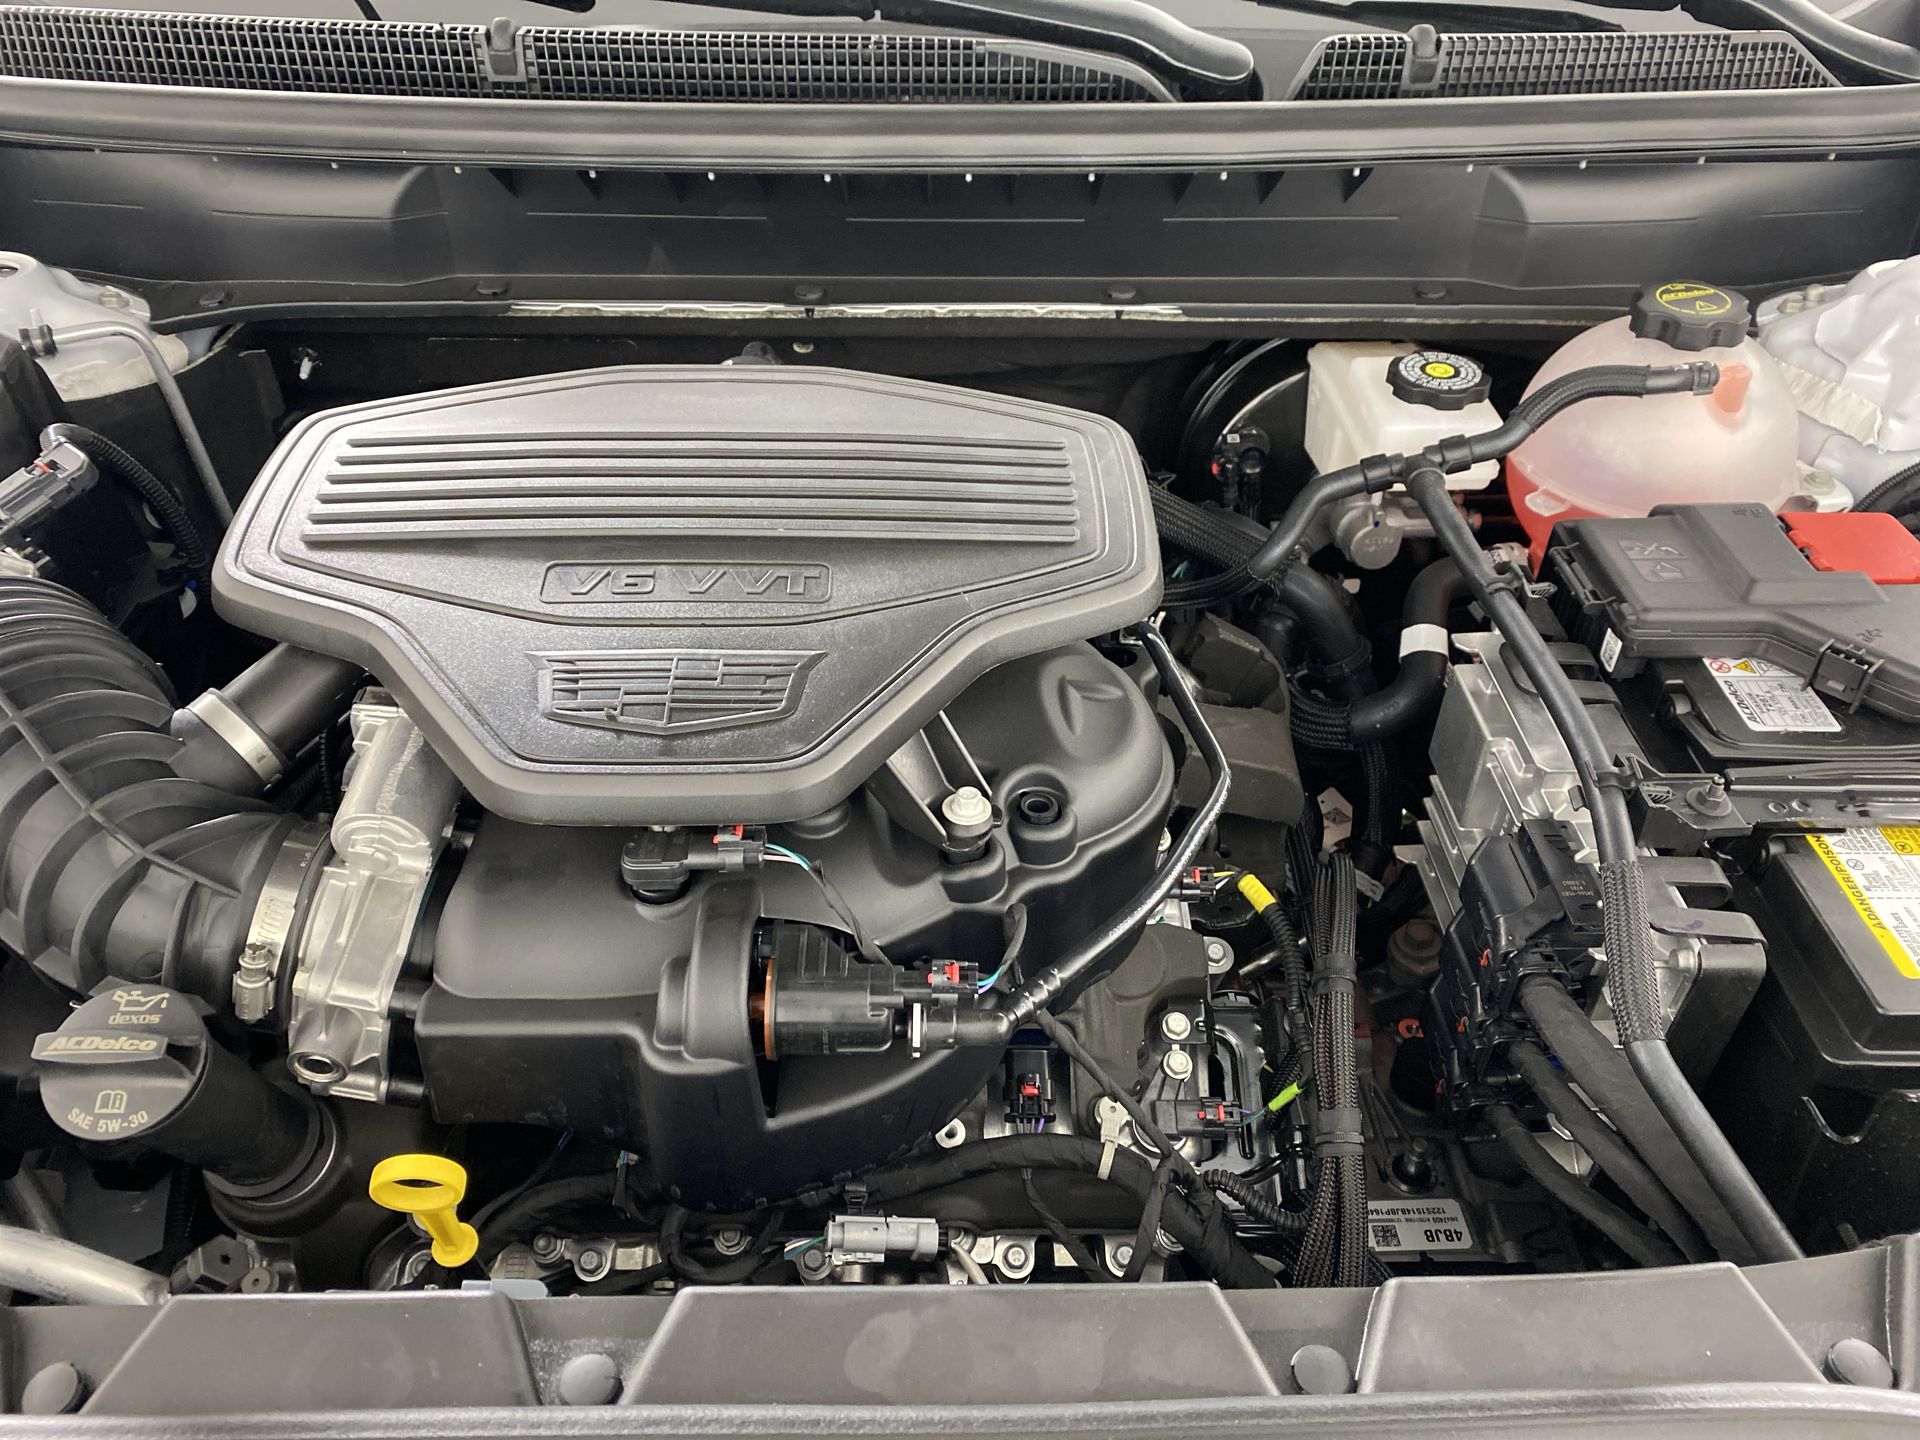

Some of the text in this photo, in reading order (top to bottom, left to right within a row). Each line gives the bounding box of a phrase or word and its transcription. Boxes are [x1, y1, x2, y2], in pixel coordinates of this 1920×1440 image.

[555, 568, 822, 595] V6 VVT
[1724, 680, 1762, 725] ACDelco
[108, 1012, 163, 1025] dexos
[47, 1036, 158, 1051] ACDelco
[67, 1107, 149, 1133] SAE 5W-30
[1424, 1228, 1463, 1243] 4BJB
